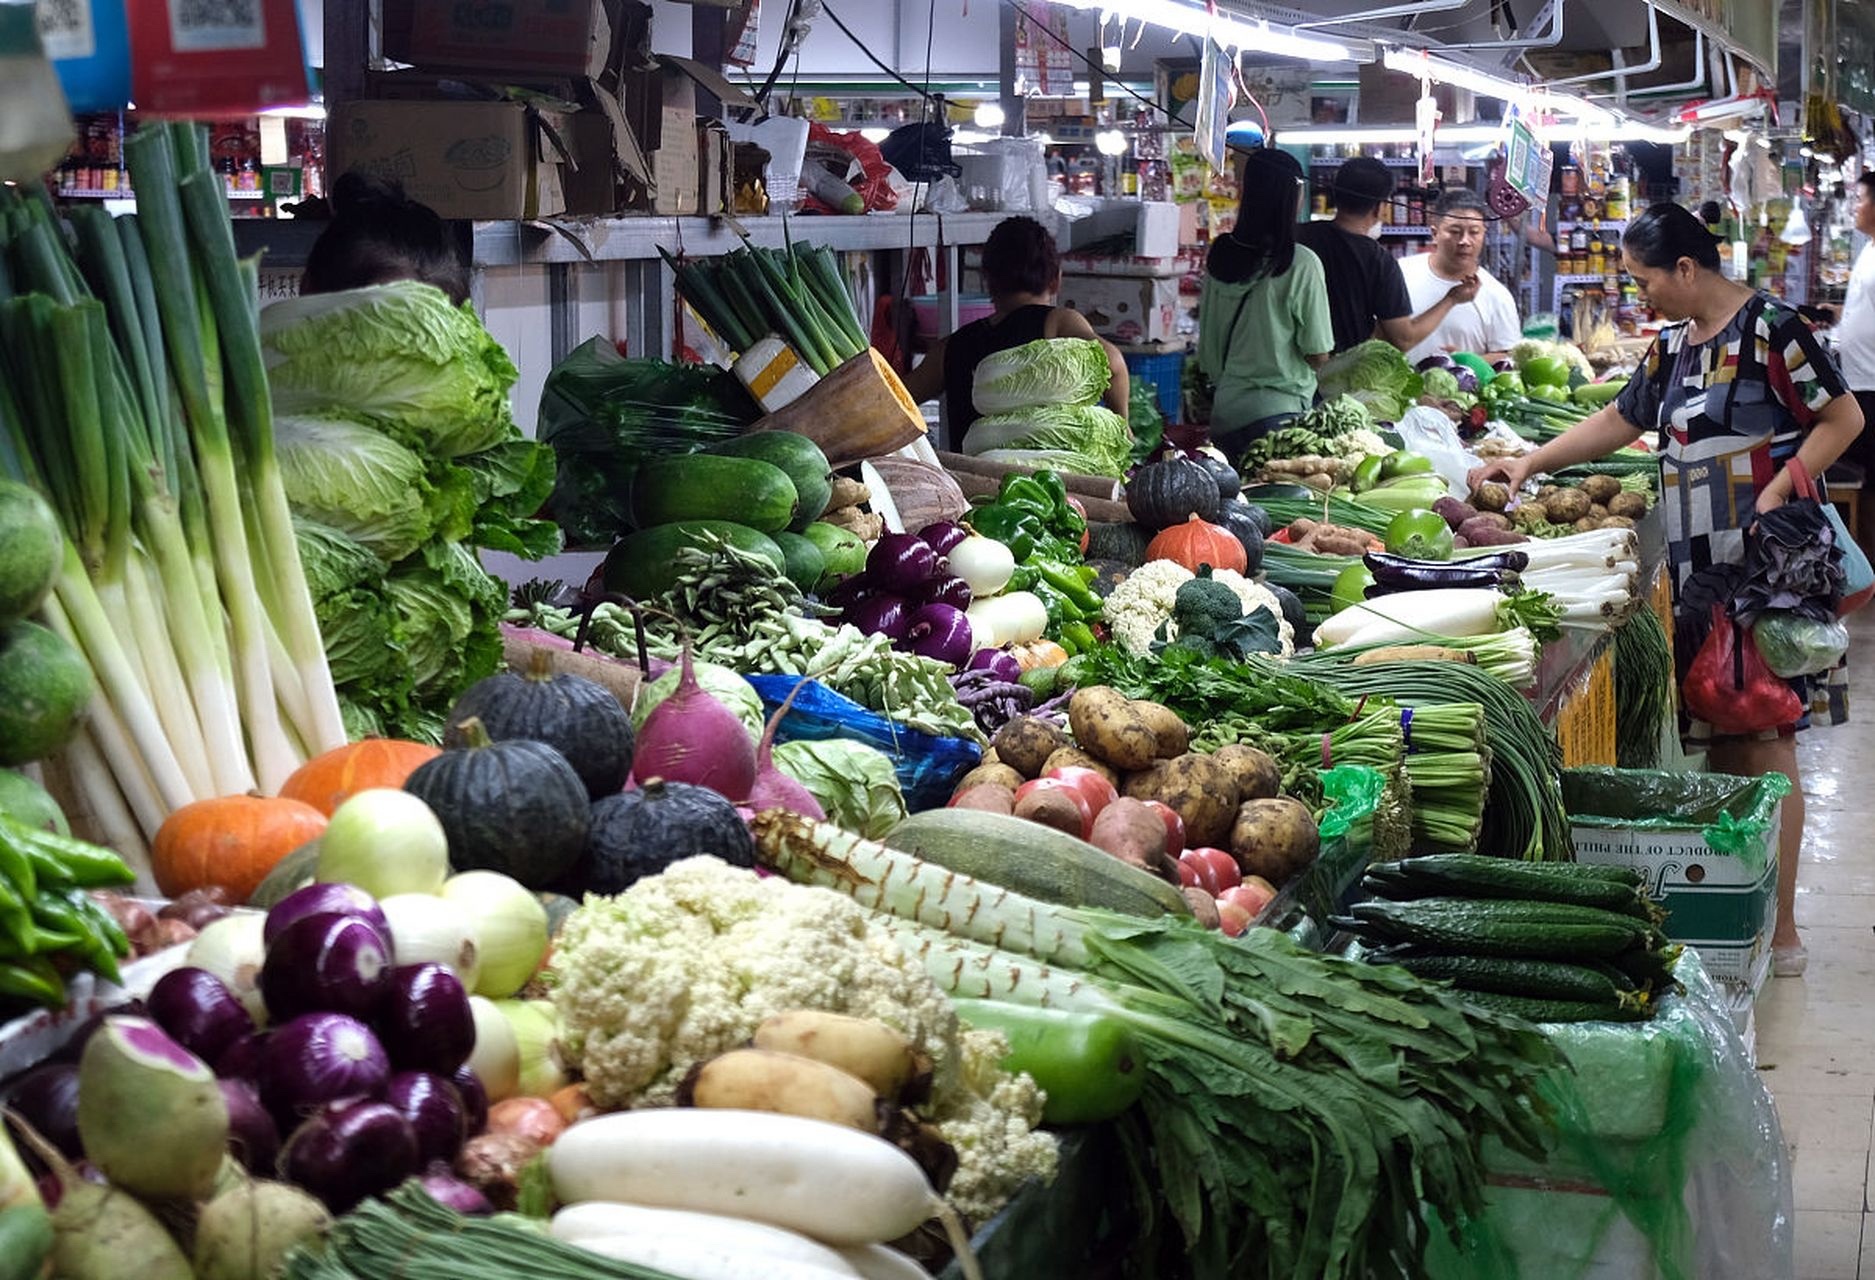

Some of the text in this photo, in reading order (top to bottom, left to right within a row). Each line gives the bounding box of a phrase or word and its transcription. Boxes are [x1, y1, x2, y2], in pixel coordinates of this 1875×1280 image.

[1615, 843, 1643, 855] THE
[1645, 844, 1663, 856] OF
[1667, 845, 1730, 857] PRODUCT
